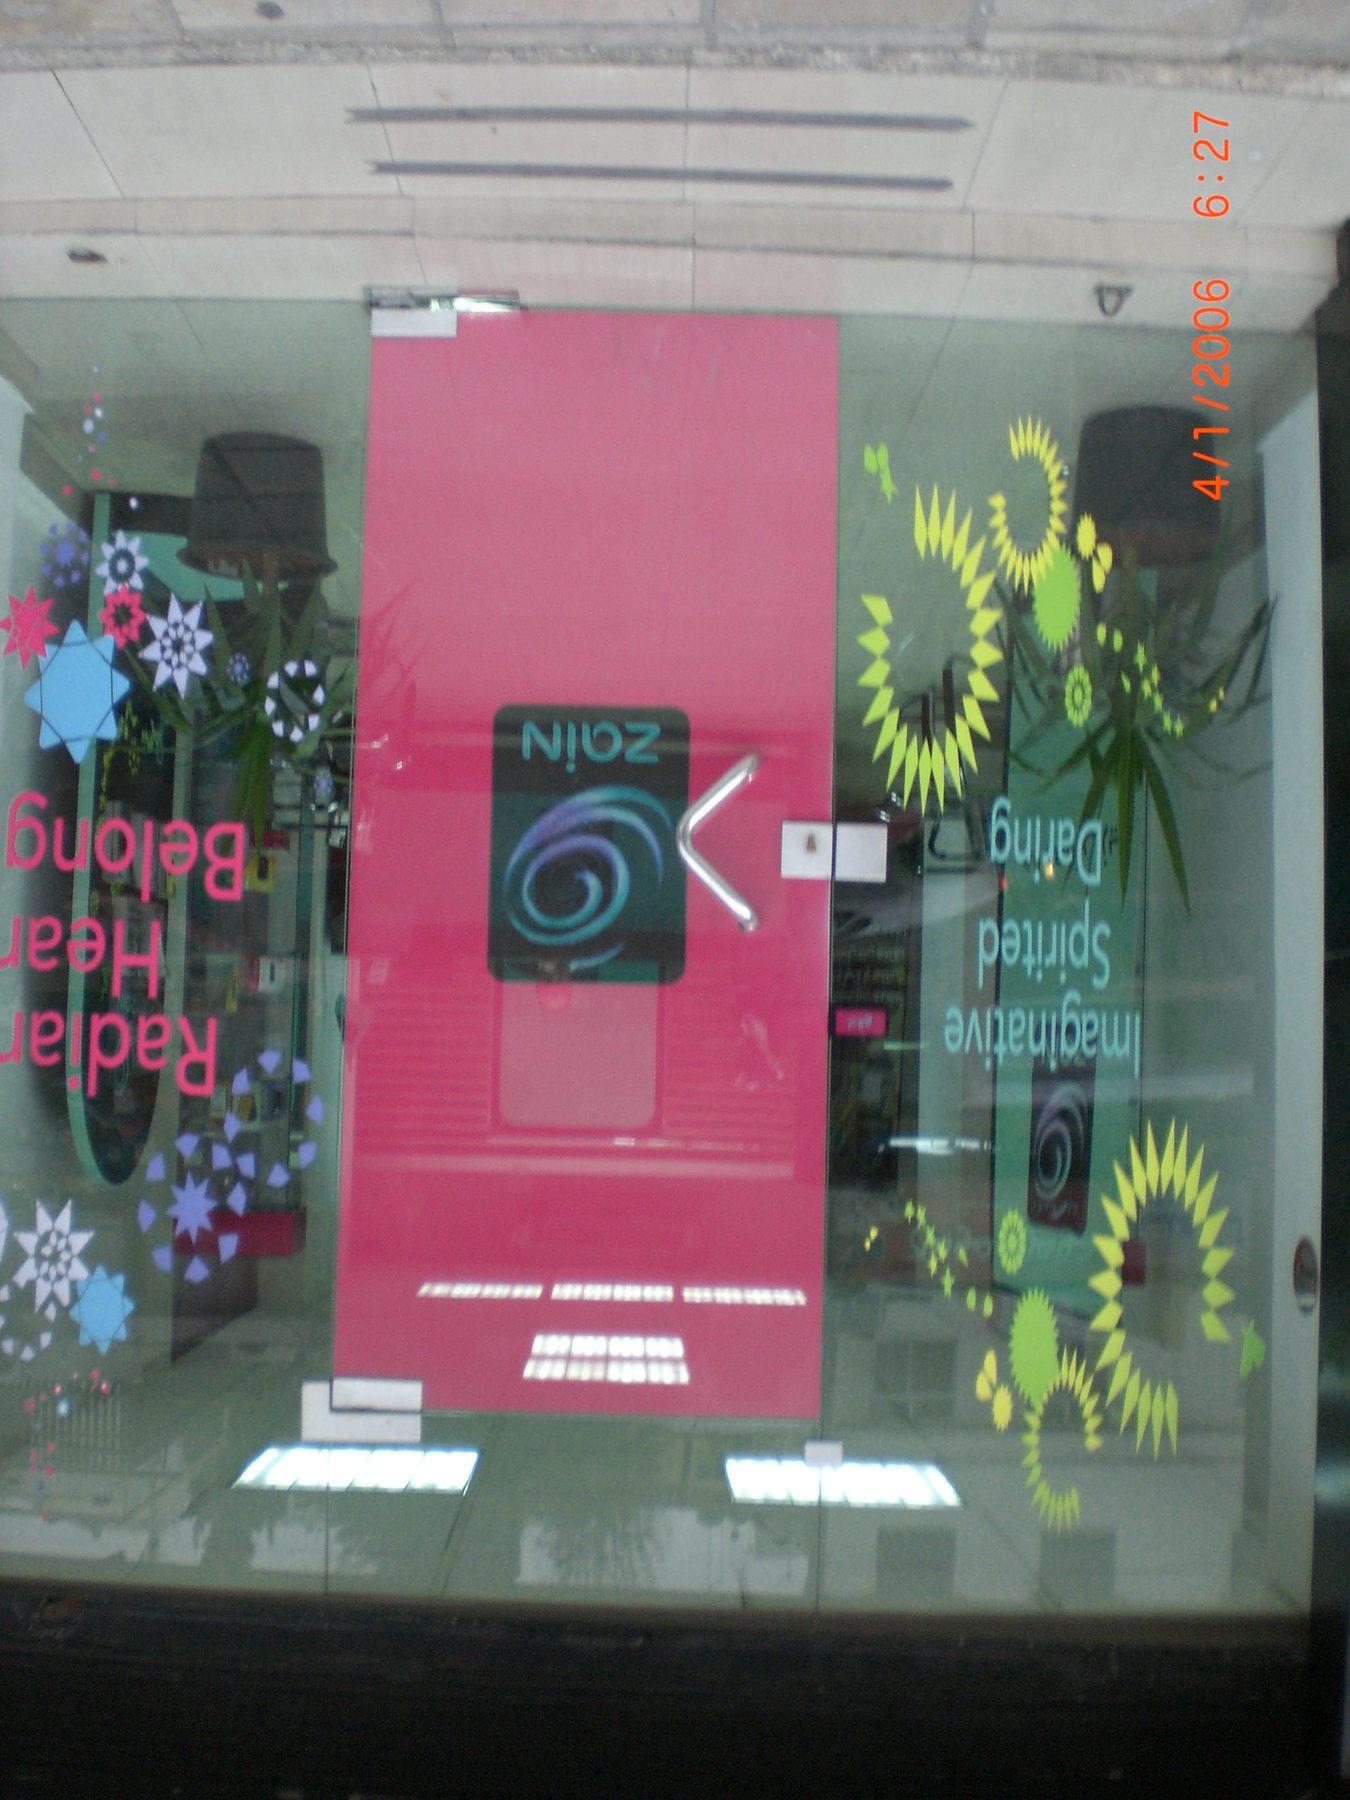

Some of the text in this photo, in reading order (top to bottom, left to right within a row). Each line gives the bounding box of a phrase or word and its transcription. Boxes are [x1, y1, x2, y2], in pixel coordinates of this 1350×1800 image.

[6, 791, 245, 903] Belong
[990, 796, 1103, 887] Daring
[977, 898, 1112, 990] Spirited
[943, 988, 1141, 1078] Imaginative
